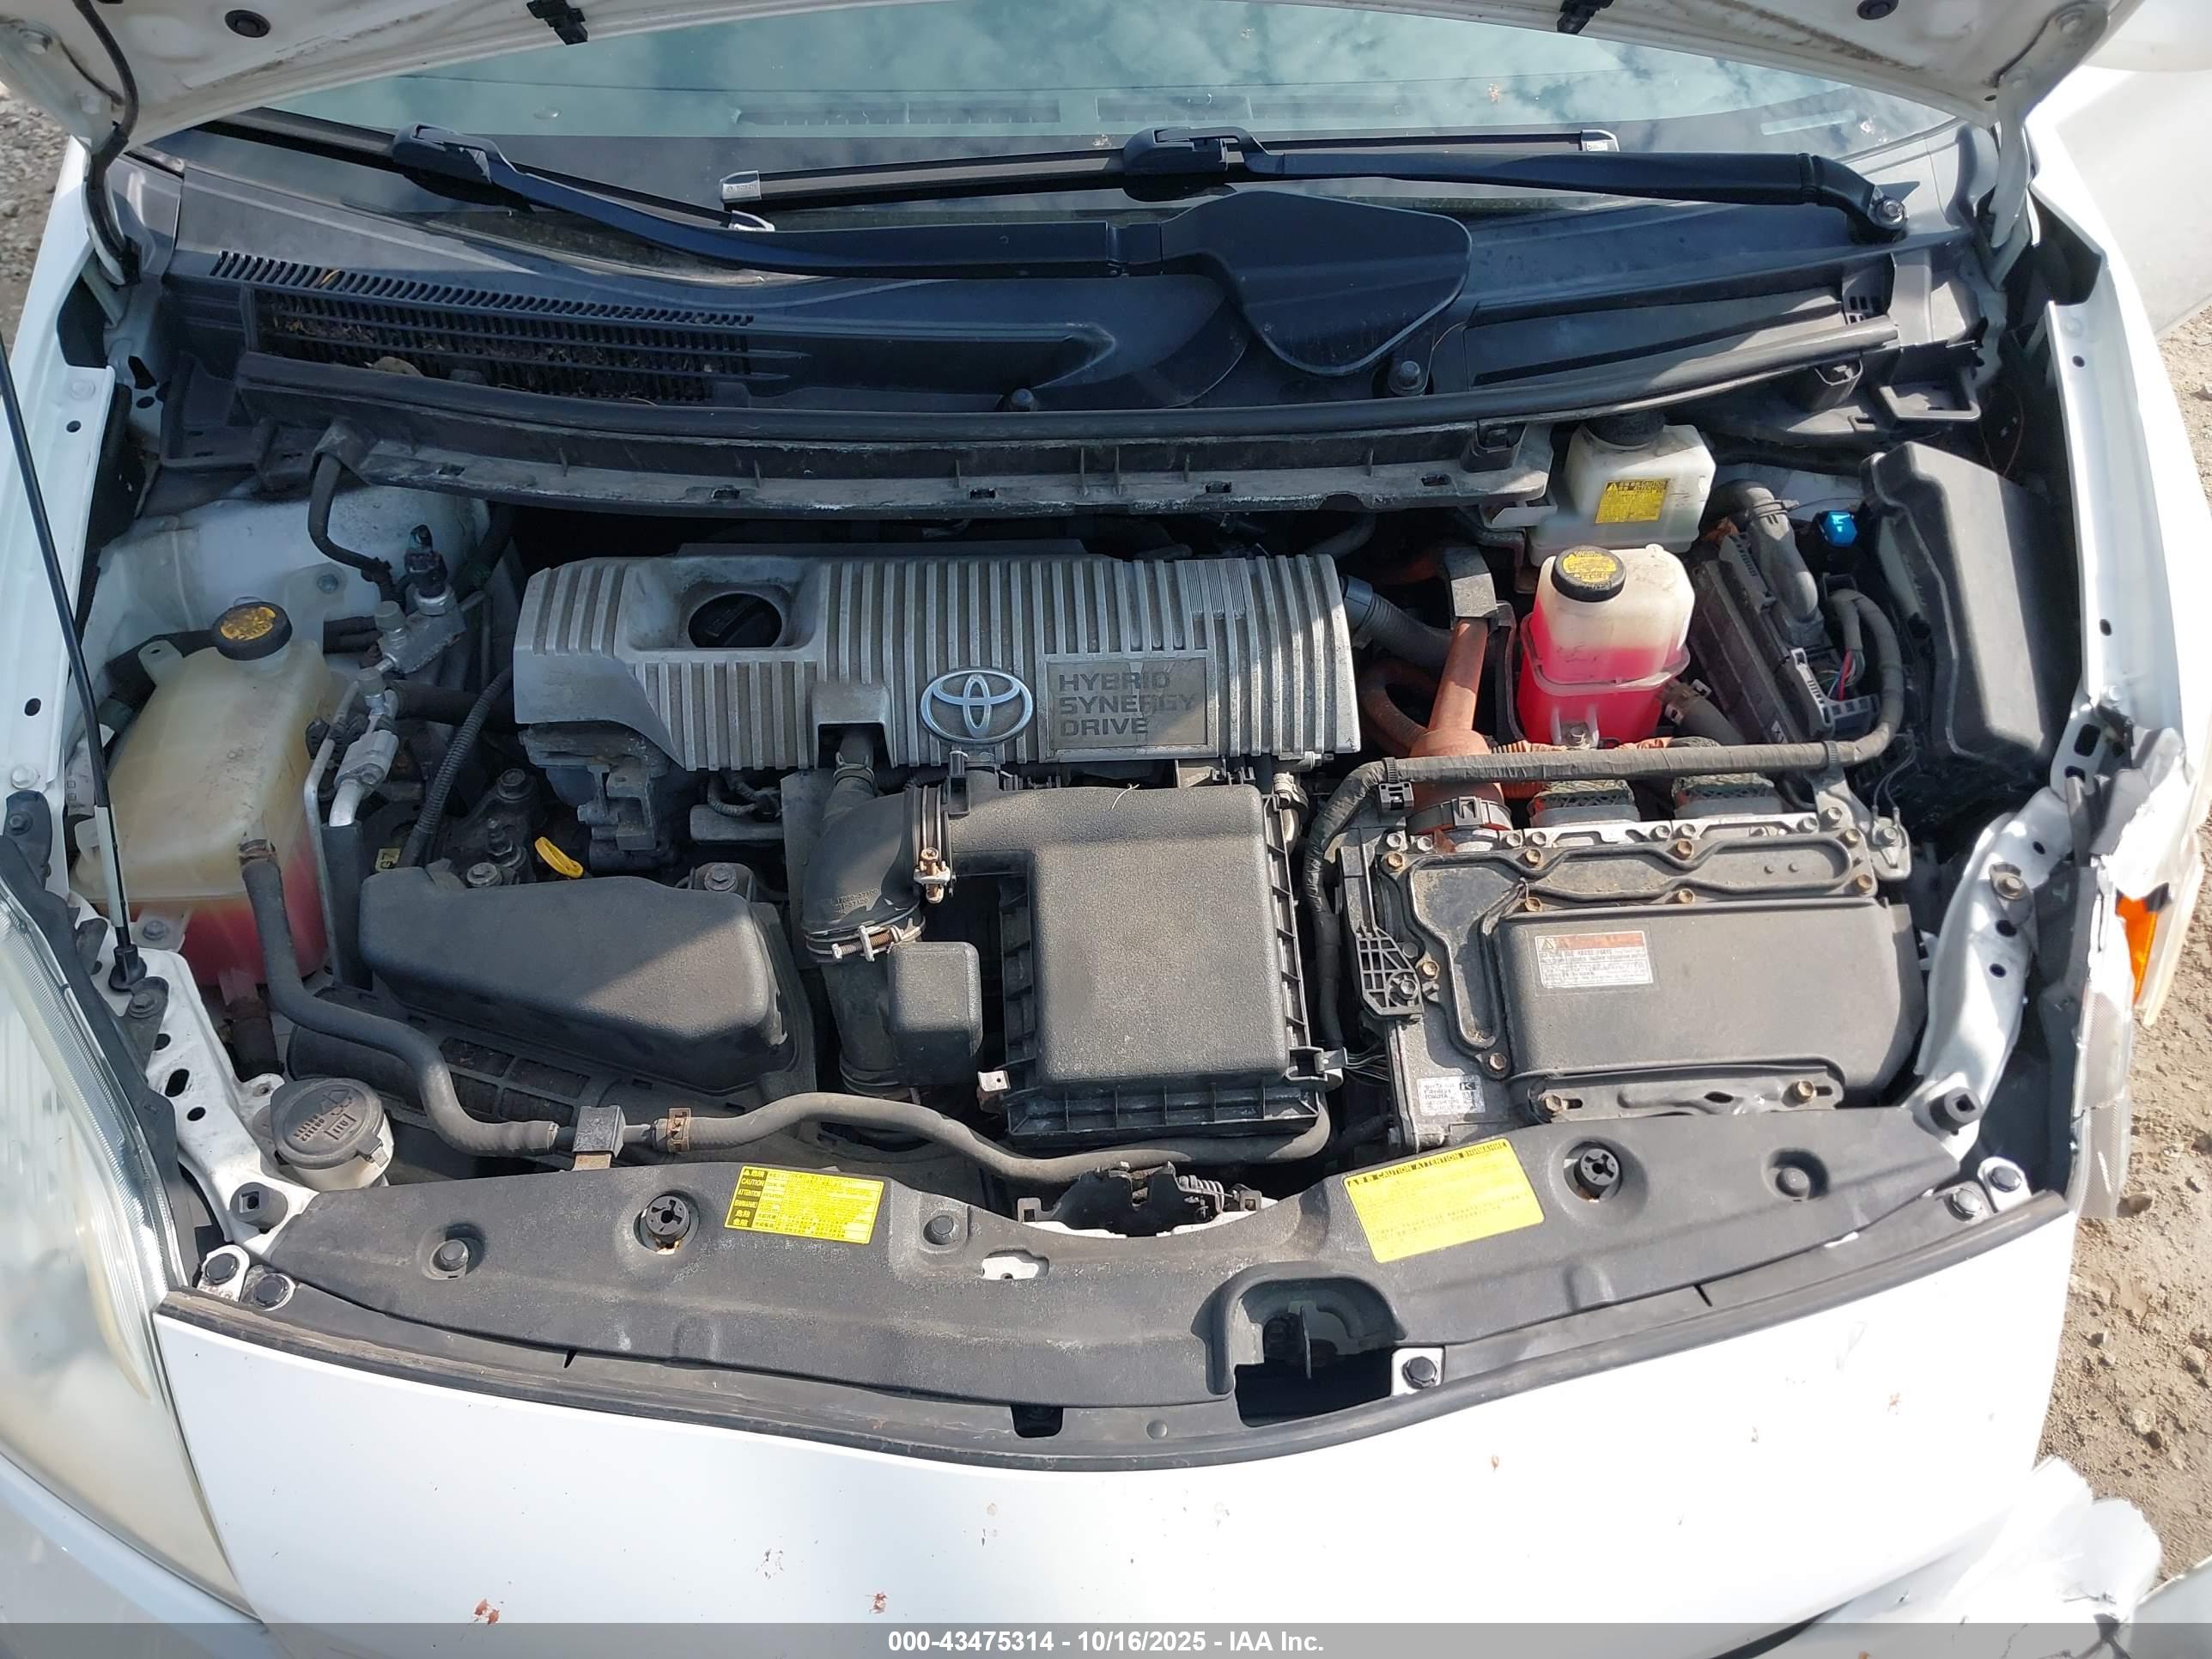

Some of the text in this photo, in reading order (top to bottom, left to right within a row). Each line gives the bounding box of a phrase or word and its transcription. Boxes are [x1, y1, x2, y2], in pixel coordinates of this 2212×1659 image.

[1059, 672, 1170, 691] HYBRID
[1059, 693, 1195, 714] SYNERGY
[1060, 718, 1149, 736] DRIVE
[1377, 1164, 1413, 1179] CAUTION
[1415, 1153, 1460, 1170] ATTENTION
[741, 1177, 765, 1187] CAUTION
[738, 1188, 762, 1197] ATTENTION
